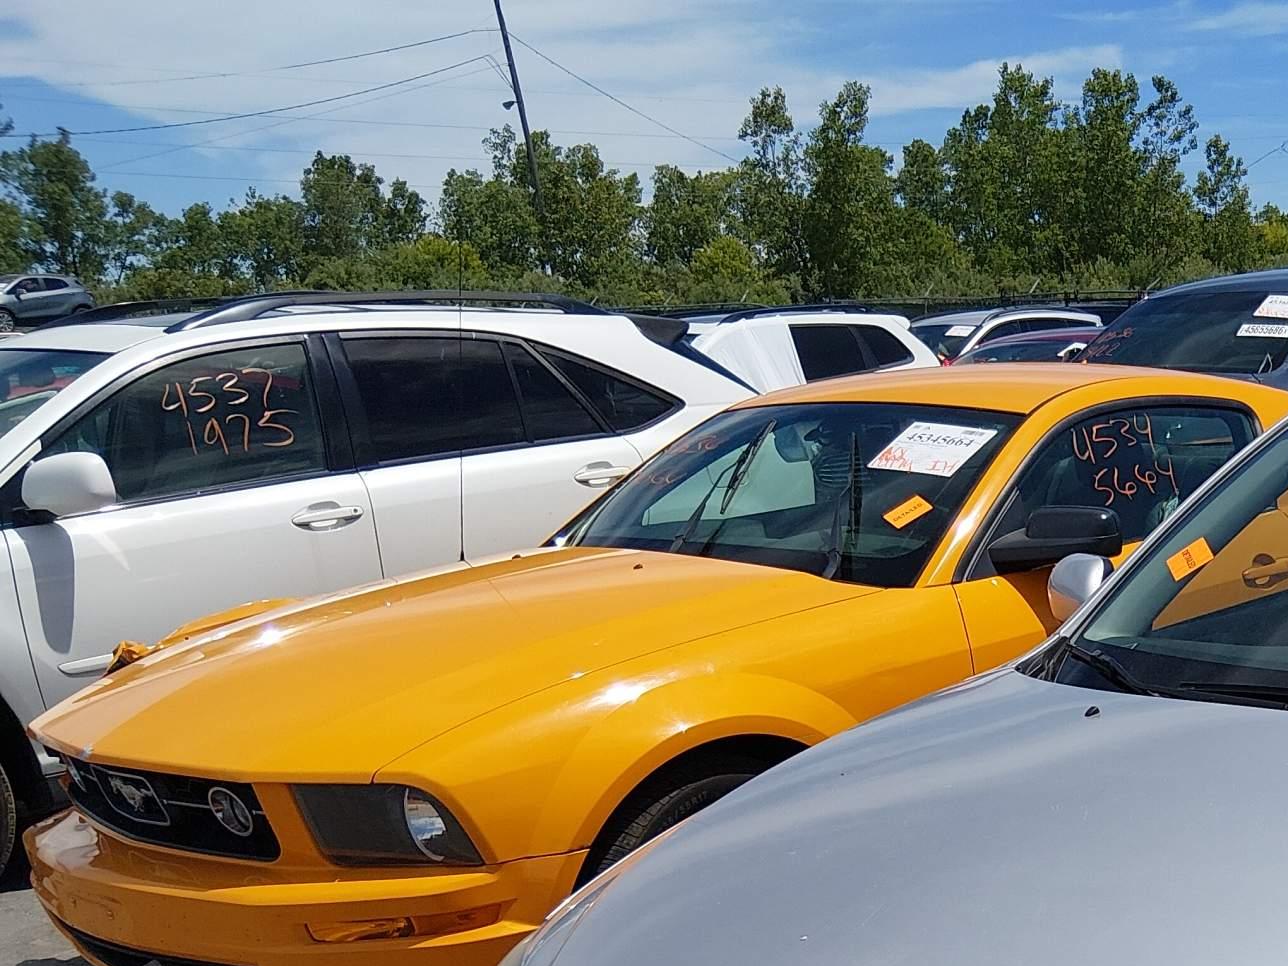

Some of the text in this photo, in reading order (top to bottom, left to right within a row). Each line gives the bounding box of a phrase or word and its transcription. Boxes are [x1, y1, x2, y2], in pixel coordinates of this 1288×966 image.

[161, 366, 273, 418] 4537
[186, 408, 300, 456] 1975
[906, 432, 975, 448] 45345664
[1070, 412, 1157, 465] 4534
[1093, 458, 1180, 506] 5664
